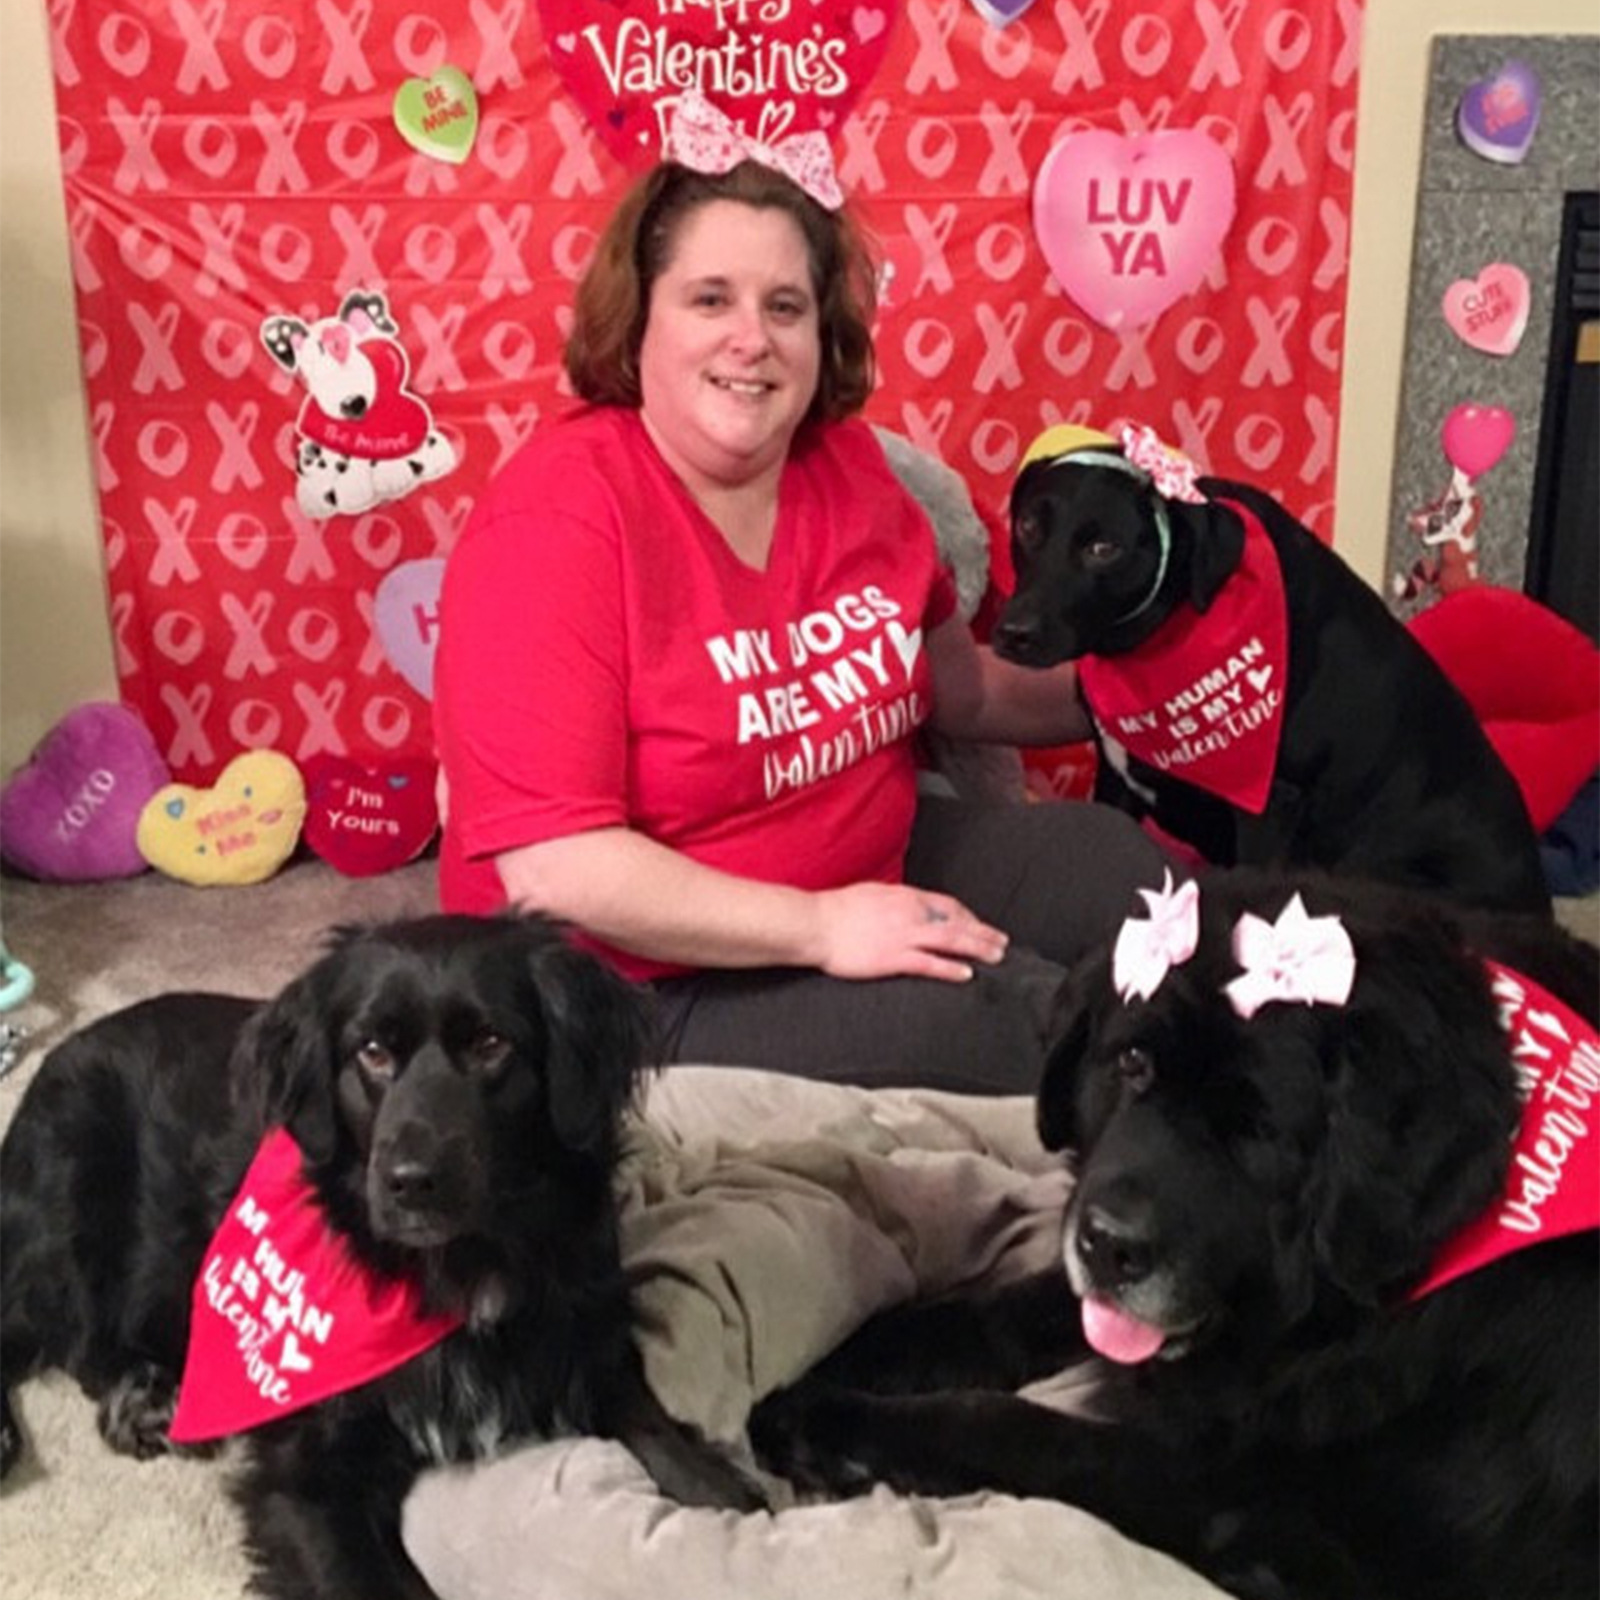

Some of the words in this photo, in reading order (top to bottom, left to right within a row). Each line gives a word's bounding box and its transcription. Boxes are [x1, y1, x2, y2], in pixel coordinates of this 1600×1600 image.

[582, 17, 850, 97] Valentine's
[422, 99, 469, 133] MINE
[424, 86, 448, 109] BE
[1087, 178, 1192, 225] LUV
[1101, 231, 1167, 277] YA
[705, 628, 781, 685] MY
[785, 585, 902, 668] DOGS
[736, 681, 822, 746] ARE
[809, 634, 891, 713] MY
[1117, 711, 1159, 735] MY
[1164, 636, 1266, 718] HUMAN
[1168, 716, 1200, 741] IS
[1200, 681, 1244, 723] MY
[345, 786, 385, 809] I'm
[326, 809, 401, 836] Yours
